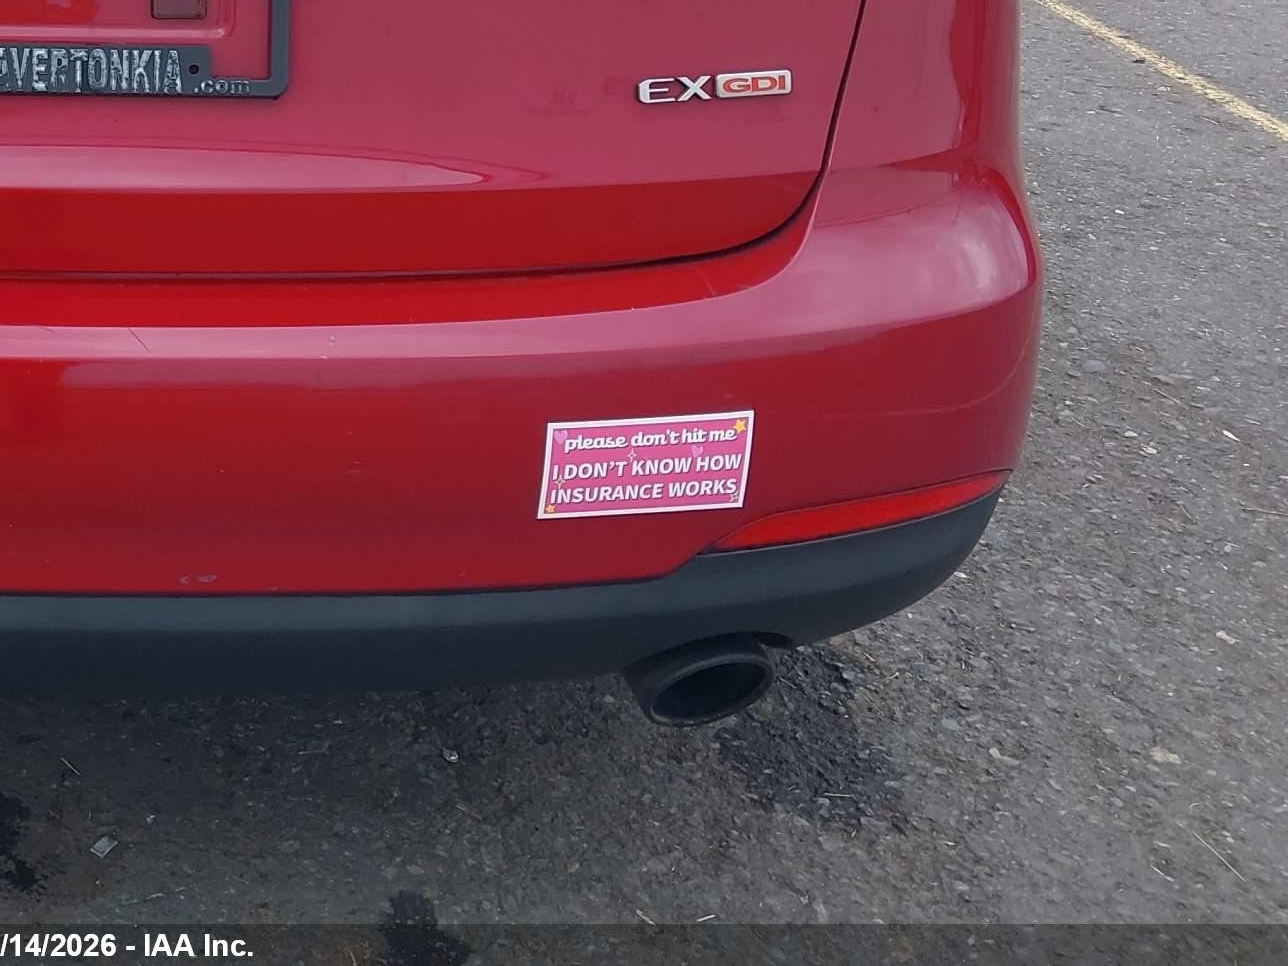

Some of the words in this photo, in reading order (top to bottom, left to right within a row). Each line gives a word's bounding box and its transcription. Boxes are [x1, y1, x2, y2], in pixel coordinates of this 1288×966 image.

[193, 79, 251, 95] .com
[638, 75, 712, 104] EX
[723, 75, 786, 93] GDI
[564, 434, 628, 454] please
[630, 430, 679, 448] don't
[681, 427, 708, 444] hit
[709, 428, 738, 442] me
[552, 464, 561, 481] I
[564, 460, 628, 480] DON'T
[631, 457, 693, 476] KNOW
[695, 453, 743, 473] HOW
[550, 483, 664, 504] INSURANCE
[667, 478, 738, 498] WORKS
